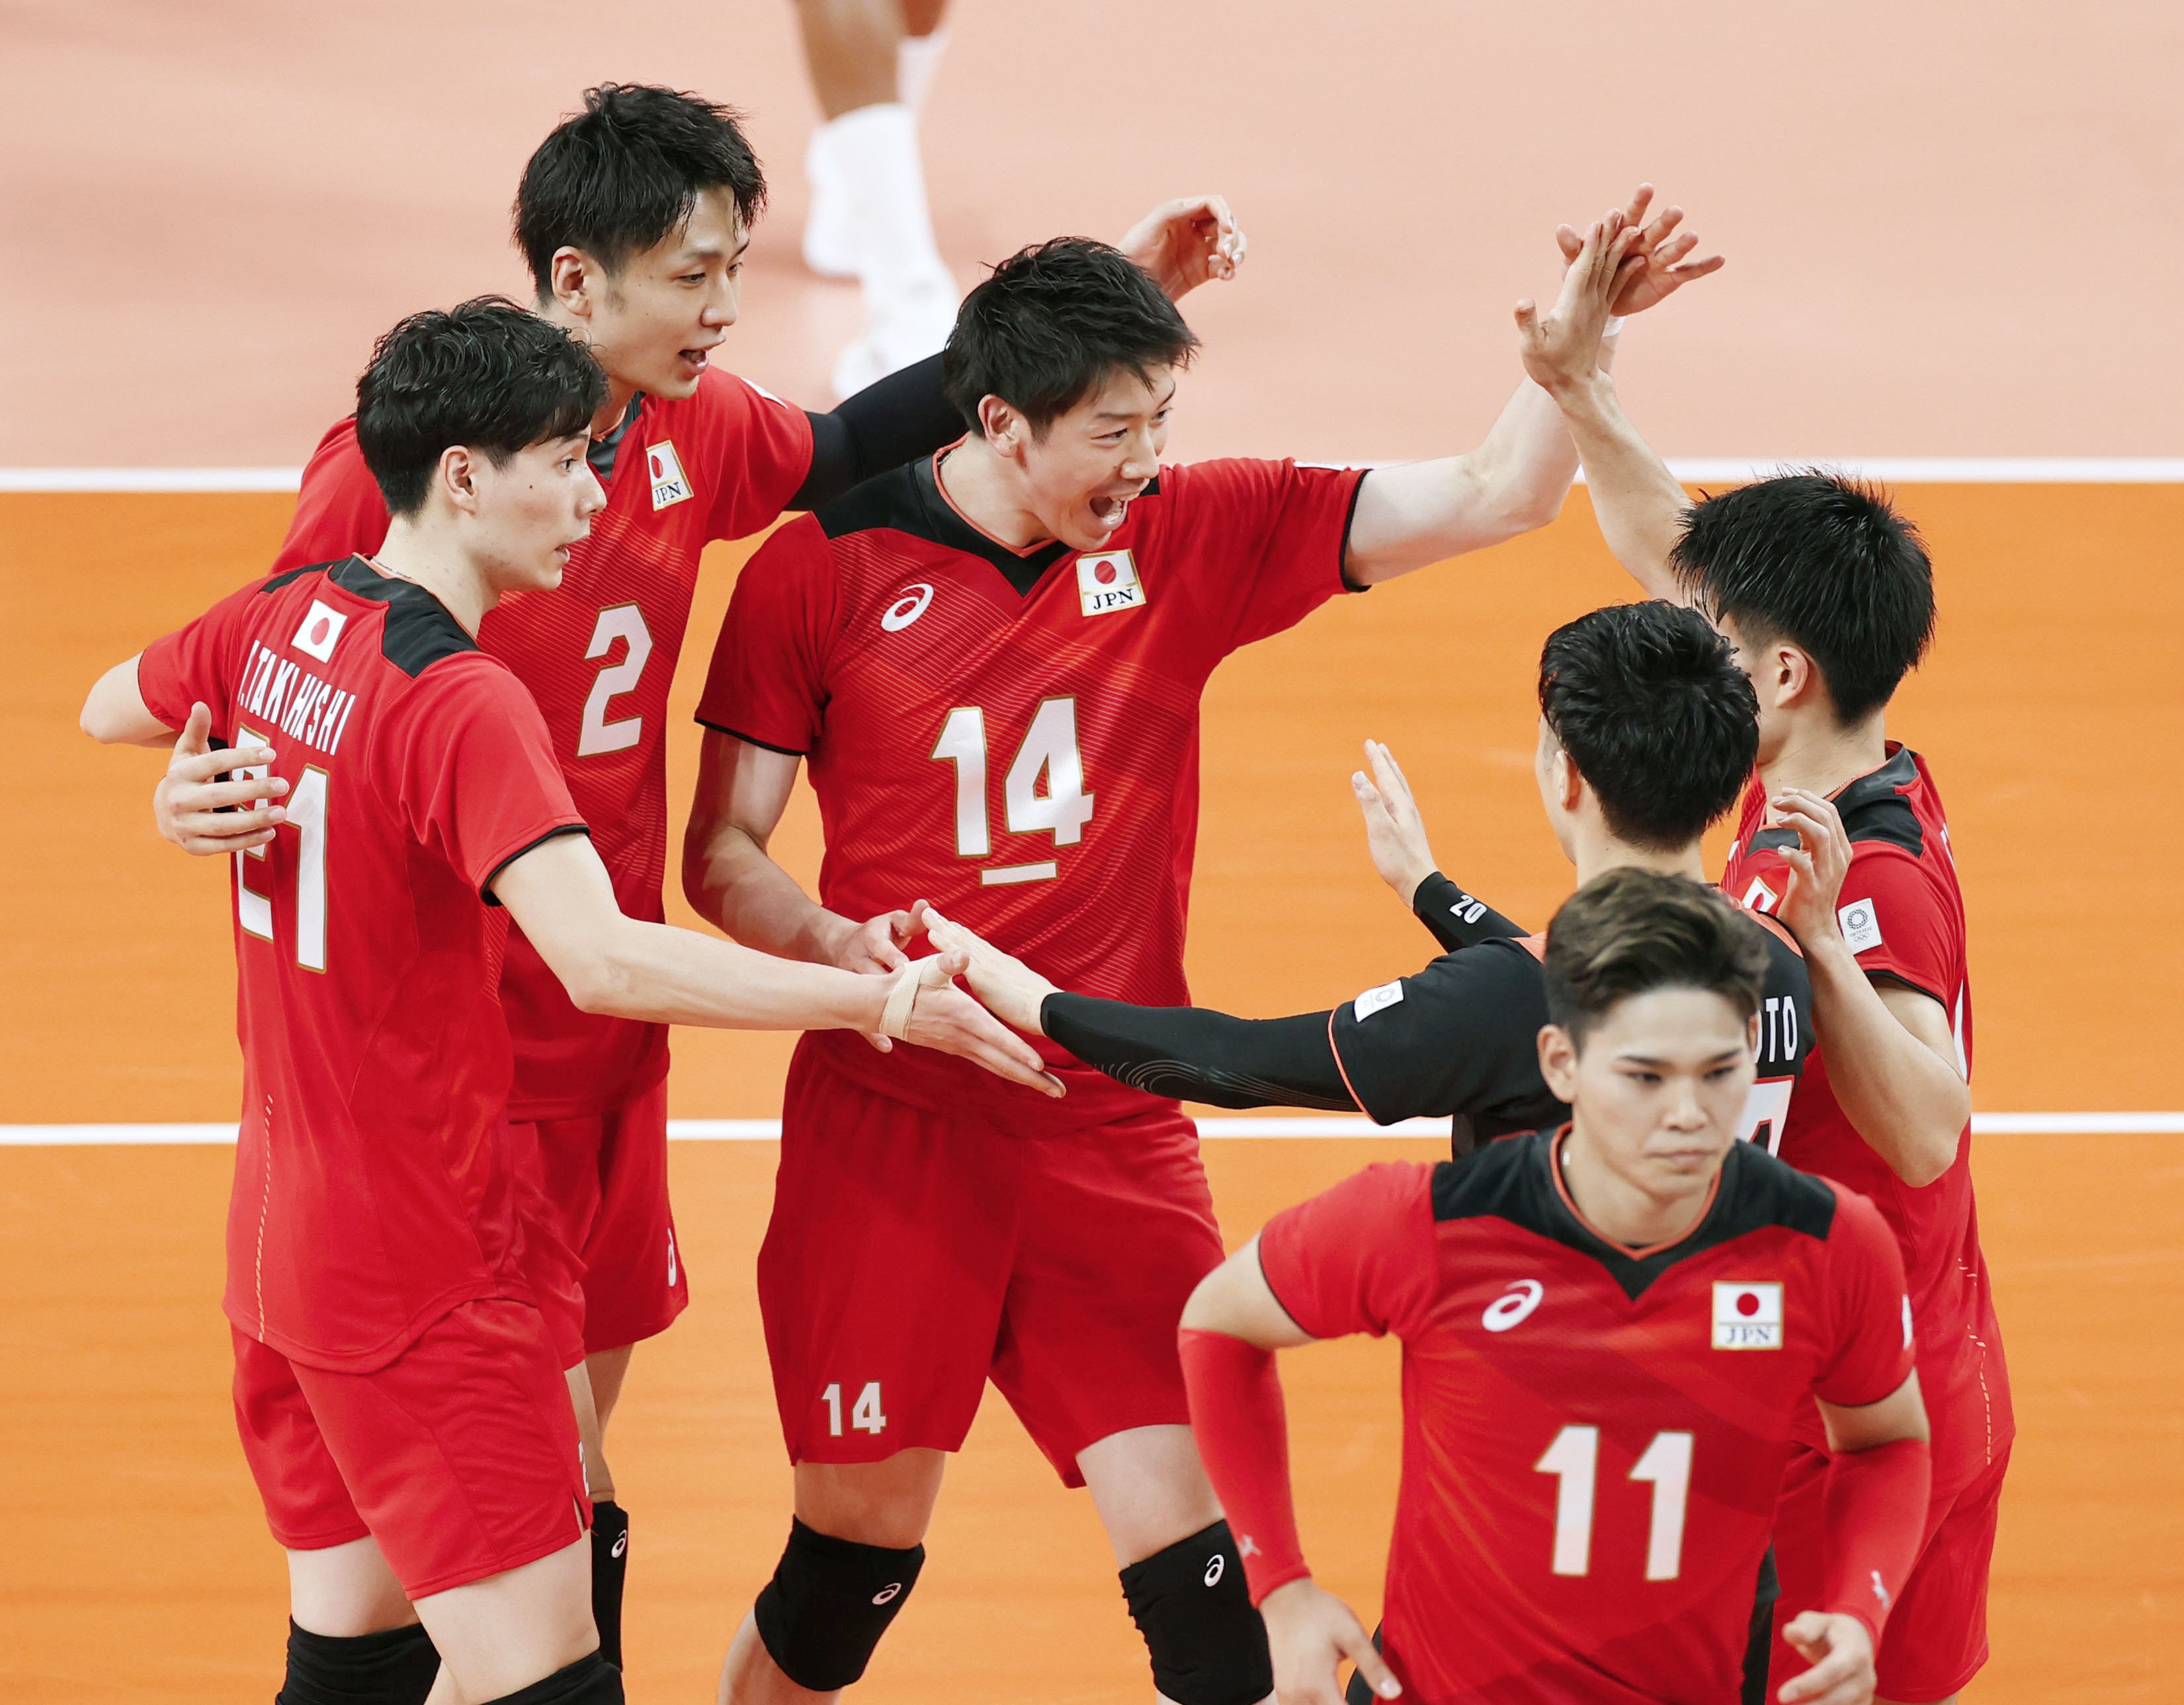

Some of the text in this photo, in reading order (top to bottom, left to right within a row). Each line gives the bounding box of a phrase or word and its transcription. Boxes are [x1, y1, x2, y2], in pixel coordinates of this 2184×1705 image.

[655, 481, 681, 504] JPN
[1093, 589, 1133, 610] JPN
[575, 600, 655, 759] 2
[929, 692, 1095, 858] 14
[231, 722, 329, 974] 21
[1449, 894, 1488, 924] 20
[1727, 1326, 1771, 1344] JPN
[821, 1380, 887, 1436] 14
[1532, 1423, 1695, 1582] 11
